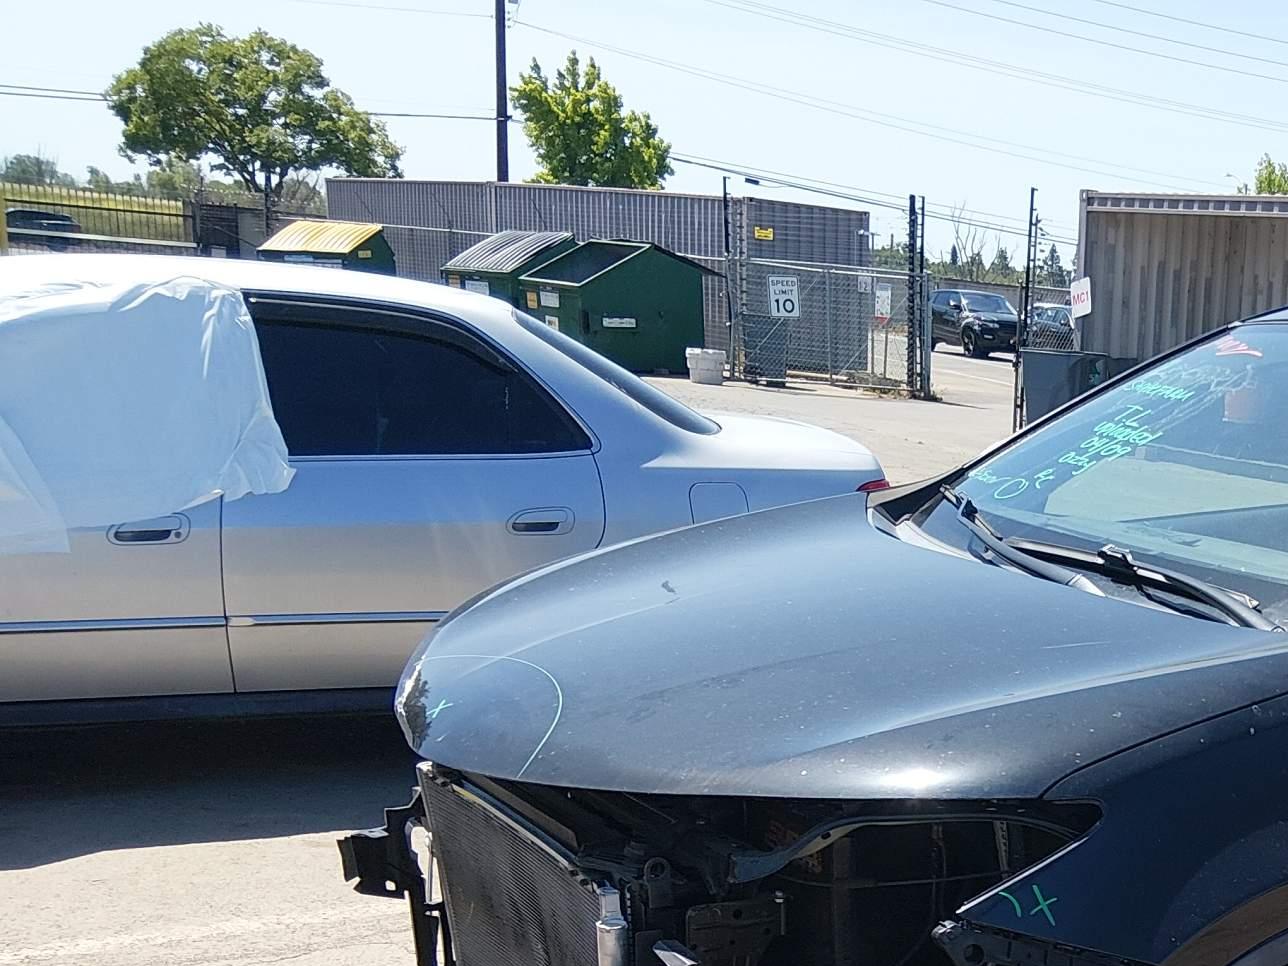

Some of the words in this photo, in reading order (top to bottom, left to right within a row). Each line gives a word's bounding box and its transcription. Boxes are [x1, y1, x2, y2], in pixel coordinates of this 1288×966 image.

[770, 279, 796, 287] SPEED
[774, 298, 795, 313] 10
[1072, 290, 1089, 306] MC1
